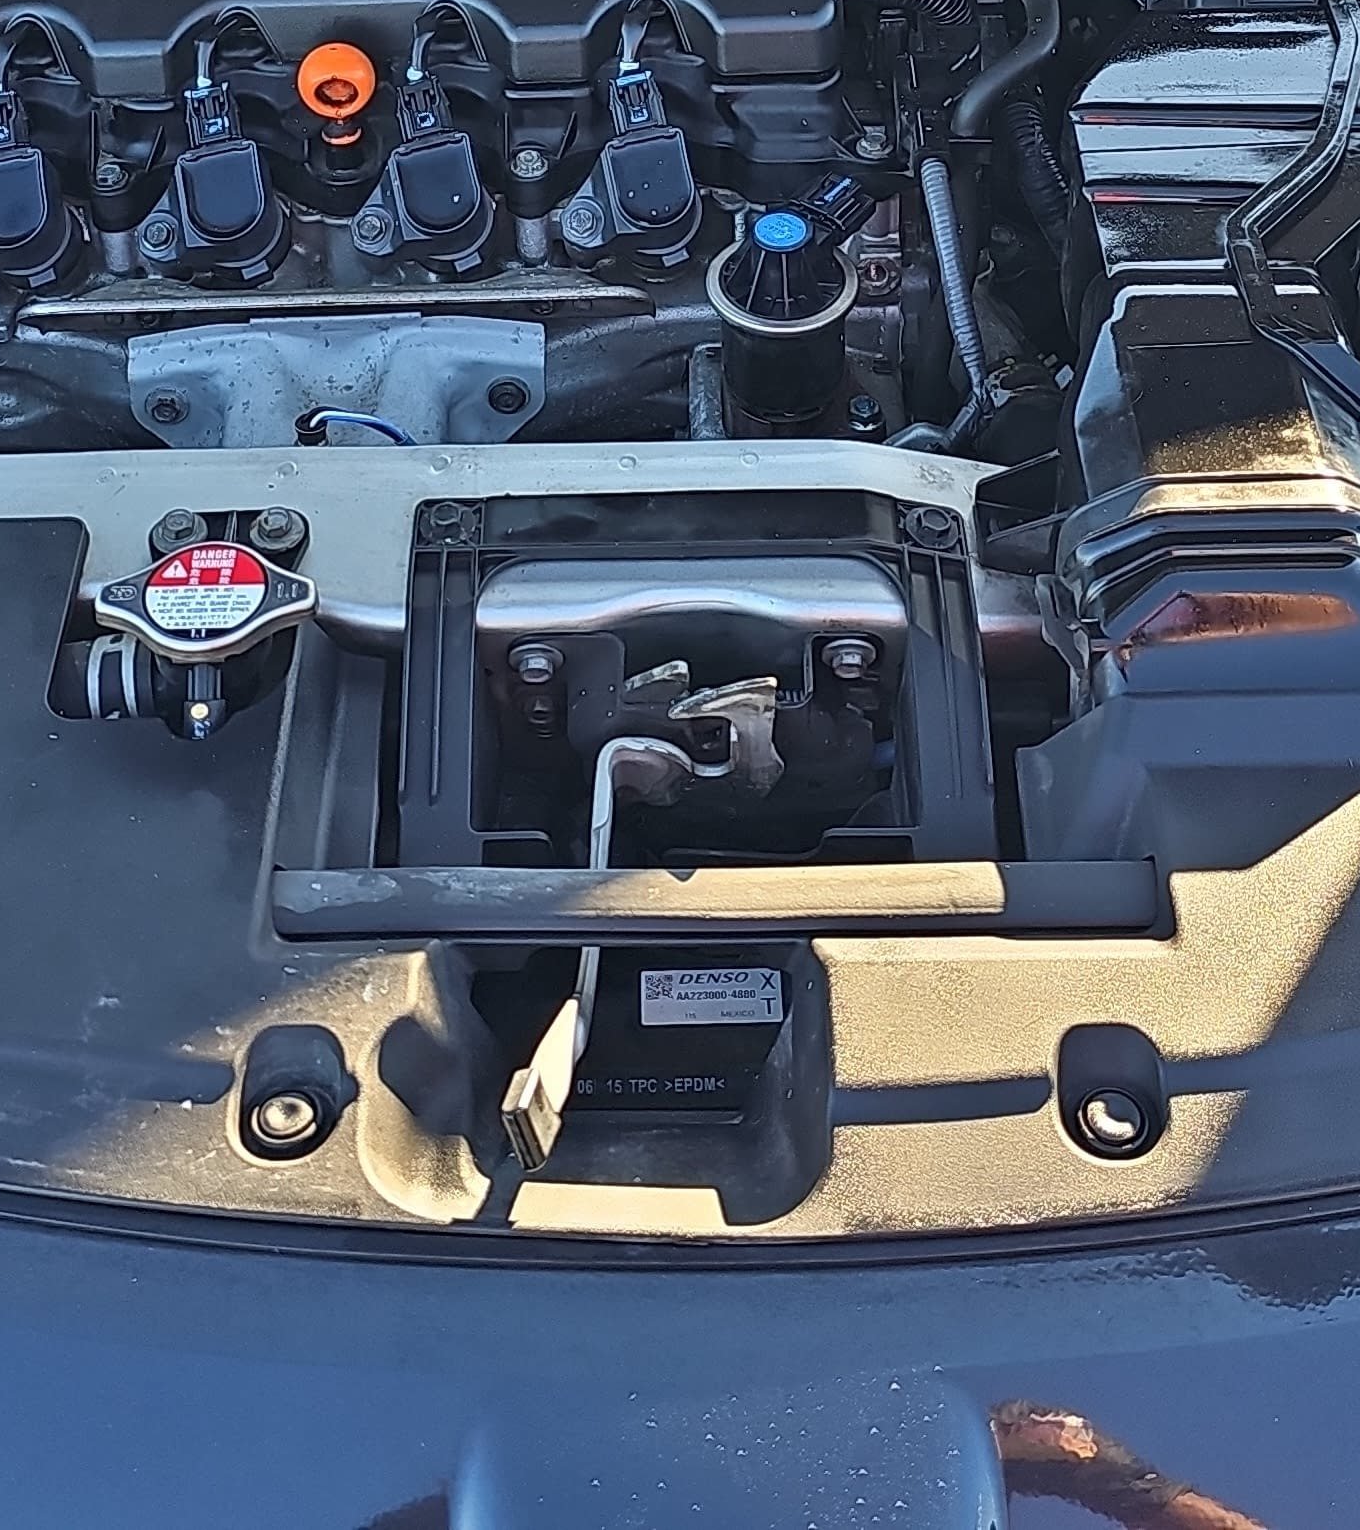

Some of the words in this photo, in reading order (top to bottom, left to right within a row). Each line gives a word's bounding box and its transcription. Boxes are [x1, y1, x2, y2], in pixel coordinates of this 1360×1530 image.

[192, 549, 237, 559] DANGER
[191, 628, 206, 638] 1.1
[679, 972, 749, 985] DENSO
[760, 972, 776, 990] X
[760, 997, 776, 1015] T
[577, 1079, 593, 1094] 06
[606, 1079, 622, 1093] 15
[629, 1079, 657, 1093] TPC
